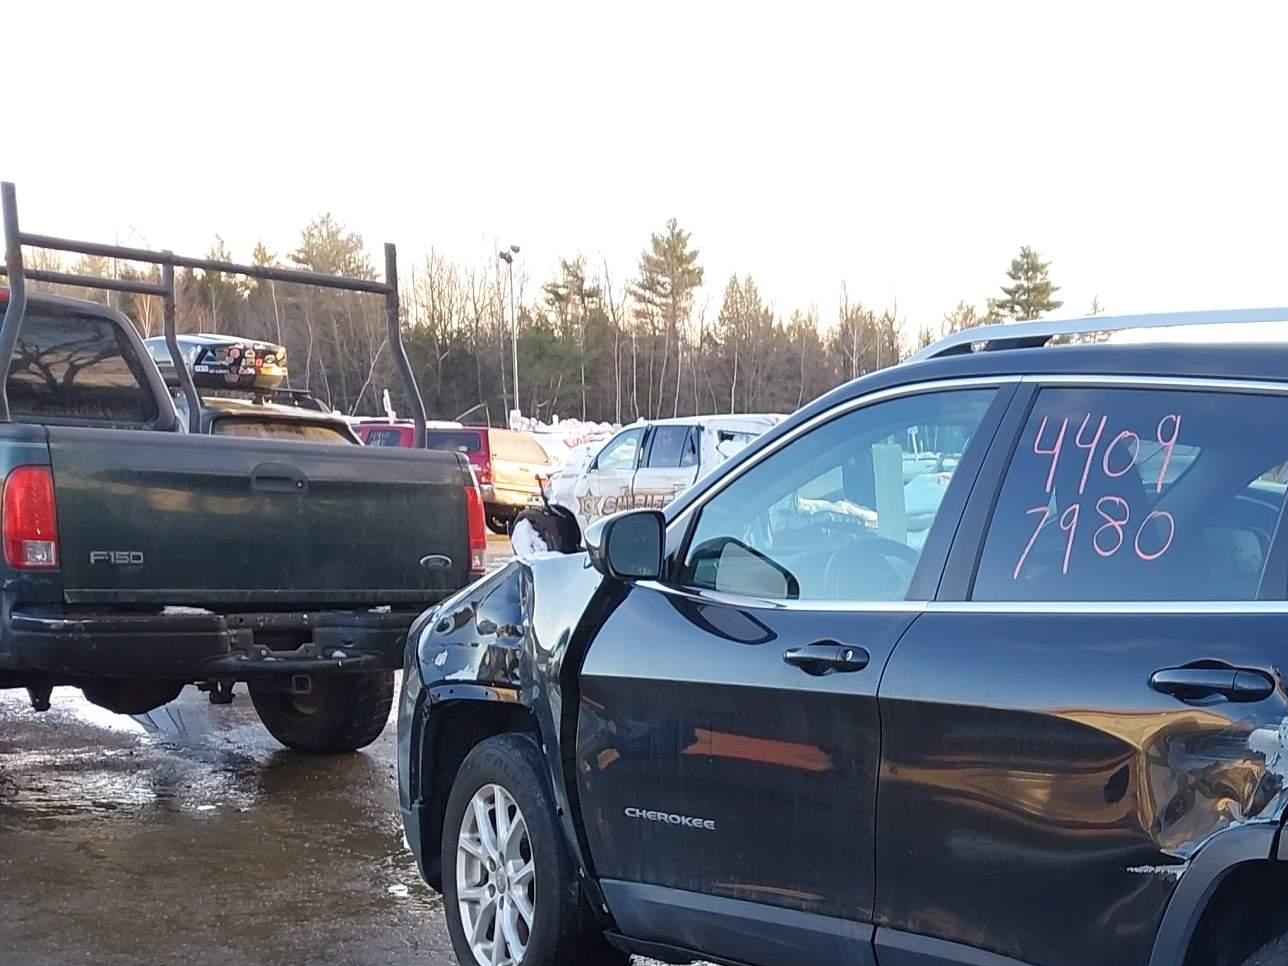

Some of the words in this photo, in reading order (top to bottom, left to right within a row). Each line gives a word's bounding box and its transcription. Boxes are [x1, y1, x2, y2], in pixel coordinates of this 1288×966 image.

[1033, 412, 1182, 495] 4409
[1013, 496, 1175, 580] 7980
[624, 807, 716, 830] CHEROKEE
